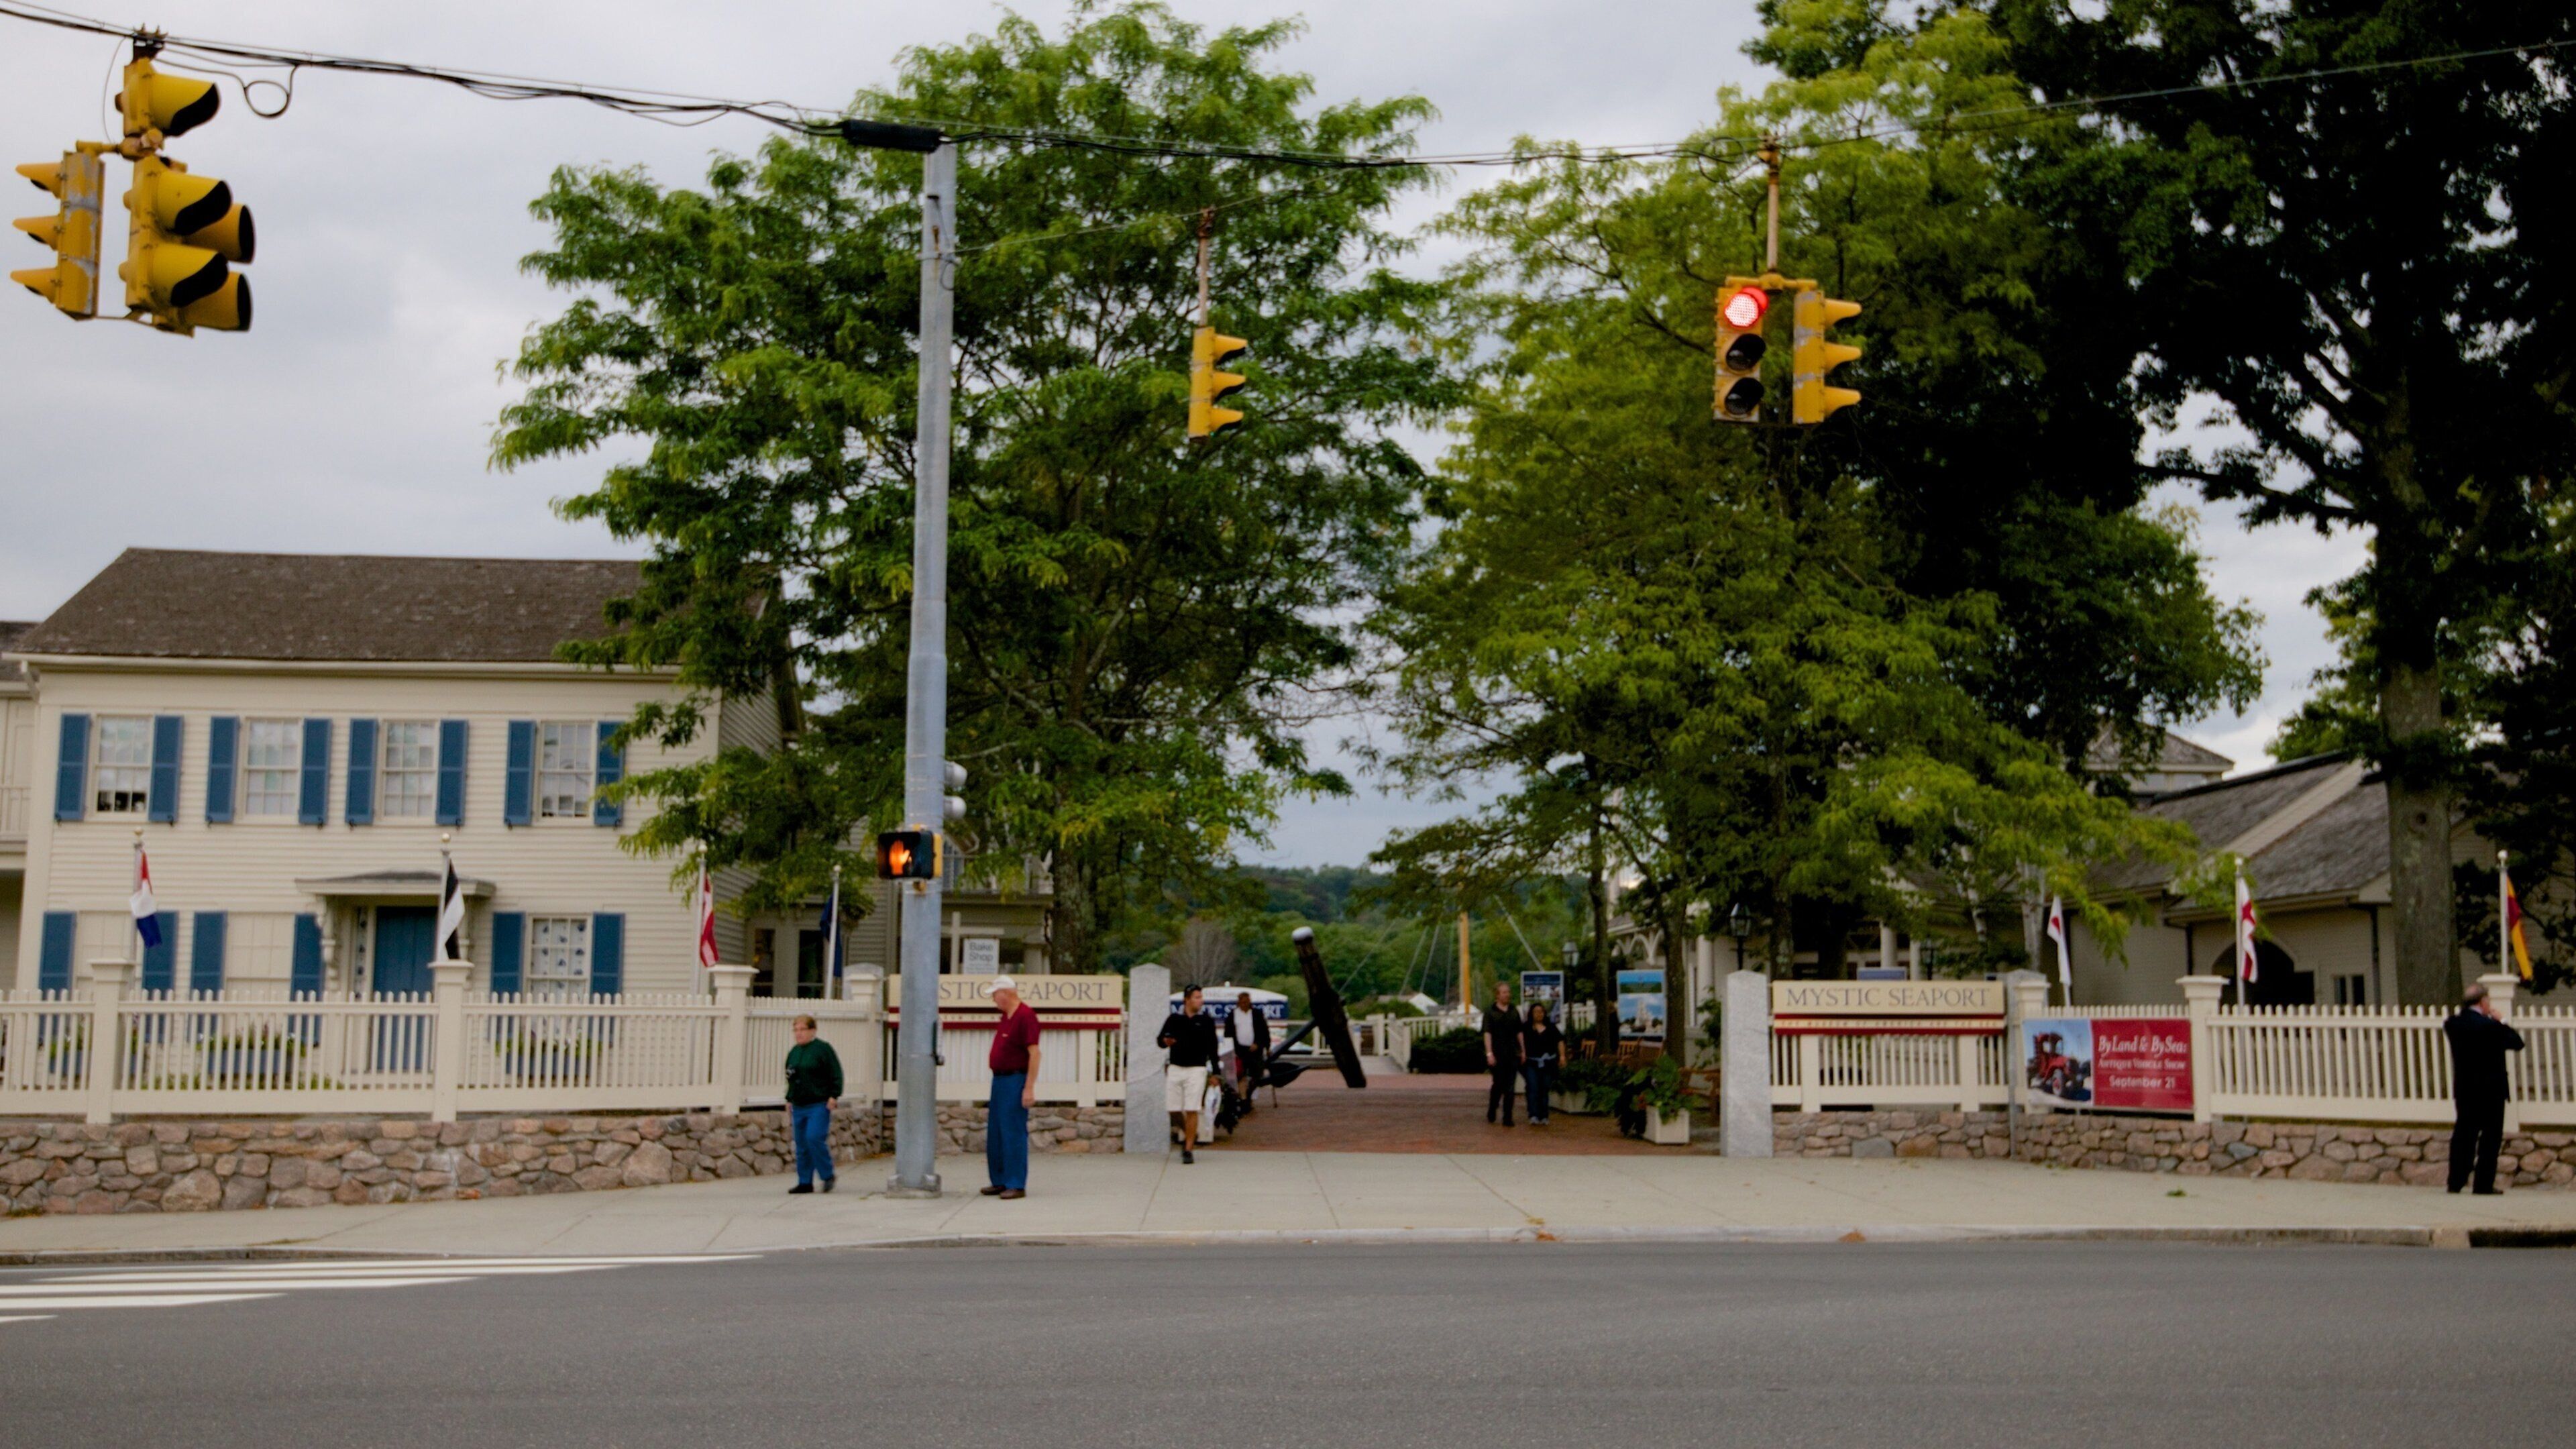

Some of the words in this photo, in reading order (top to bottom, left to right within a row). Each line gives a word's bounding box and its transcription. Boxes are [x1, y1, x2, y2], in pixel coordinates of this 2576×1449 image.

[969, 942, 994, 951] Bake
[969, 953, 994, 963] Shop
[939, 982, 994, 1001] STIC
[1016, 982, 1110, 1001] EAPORT
[1786, 987, 1880, 1006] MYSTIC
[1888, 987, 1991, 1006] SEAPORT
[2098, 1035, 2111, 1057] By
[2112, 1035, 2139, 1053] Land
[2139, 1036, 2148, 1052] &
[2151, 1035, 2165, 1058] By
[2108, 1075, 2161, 1088] September
[2164, 1076, 2176, 1089] 21
